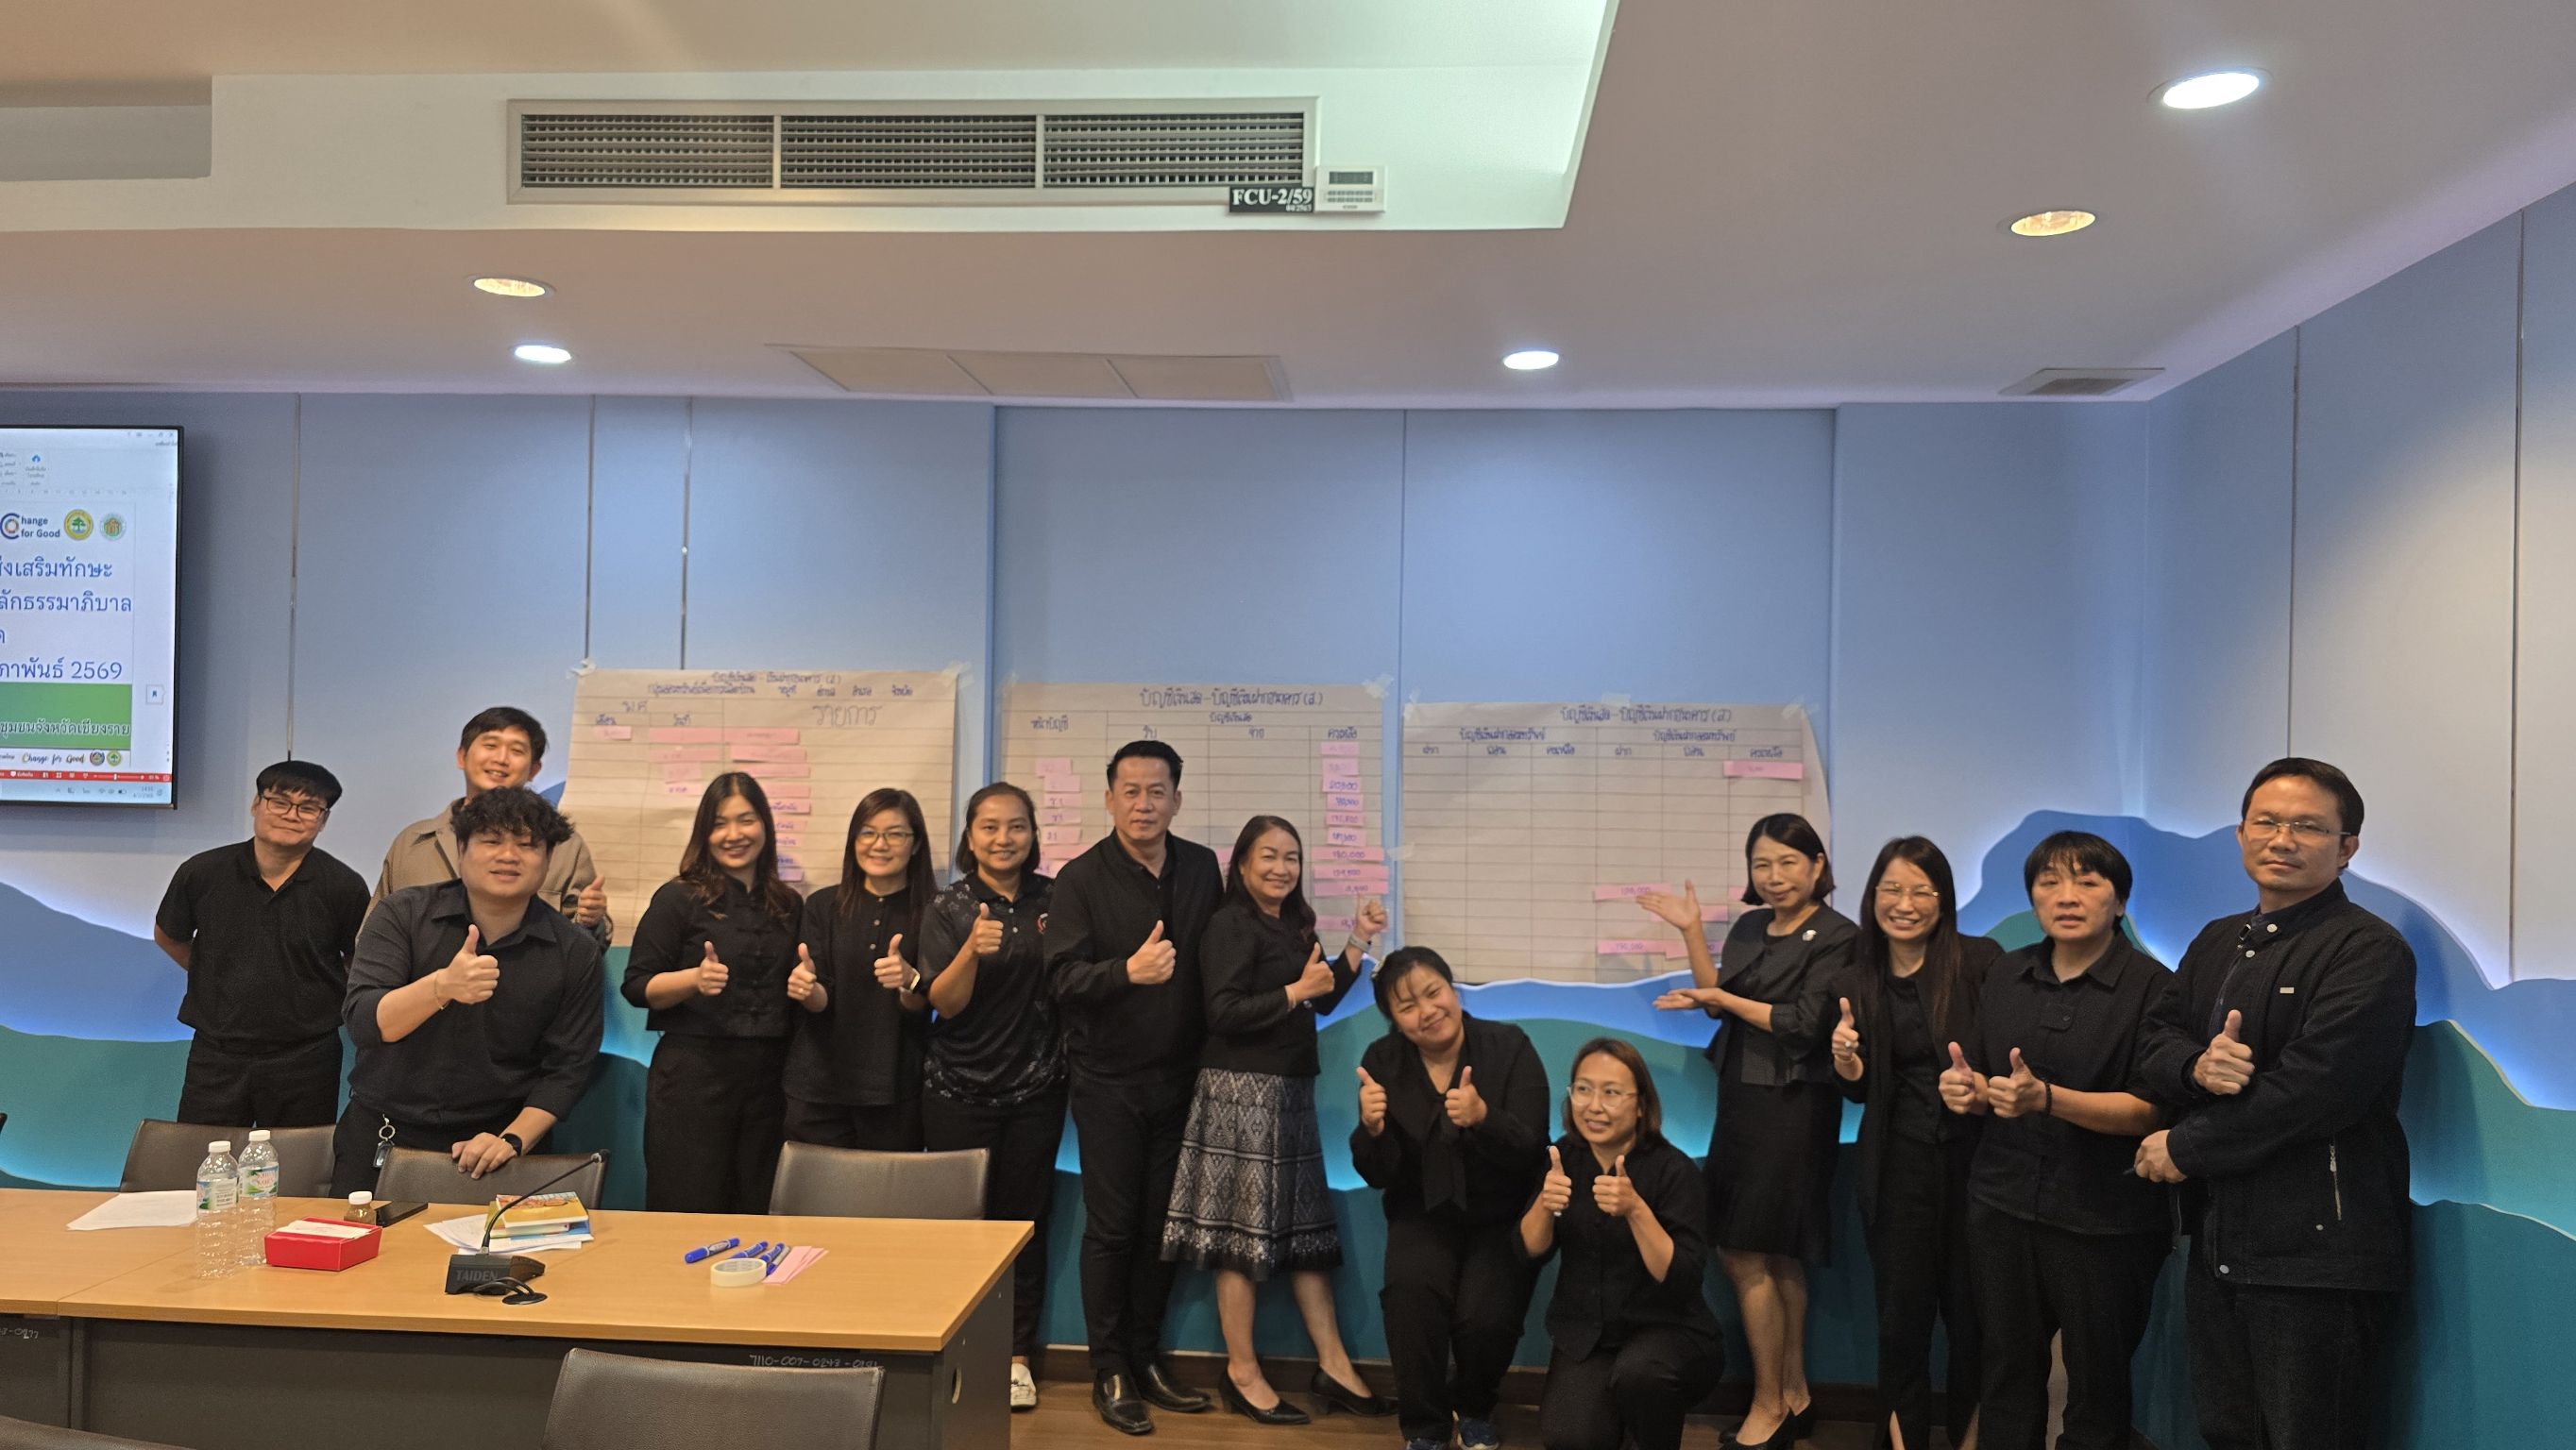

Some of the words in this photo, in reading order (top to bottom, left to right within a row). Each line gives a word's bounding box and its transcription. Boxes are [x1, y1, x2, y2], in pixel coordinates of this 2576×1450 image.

[1231, 188, 1313, 206] FCU-2/59
[21, 529, 34, 538] for
[36, 529, 60, 538] Good
[0, 555, 112, 578] ่งเสริมทักษะ
[71, 661, 123, 680] 2569
[812, 705, 883, 726] รายการ
[455, 1270, 498, 1282] TAIDEN
